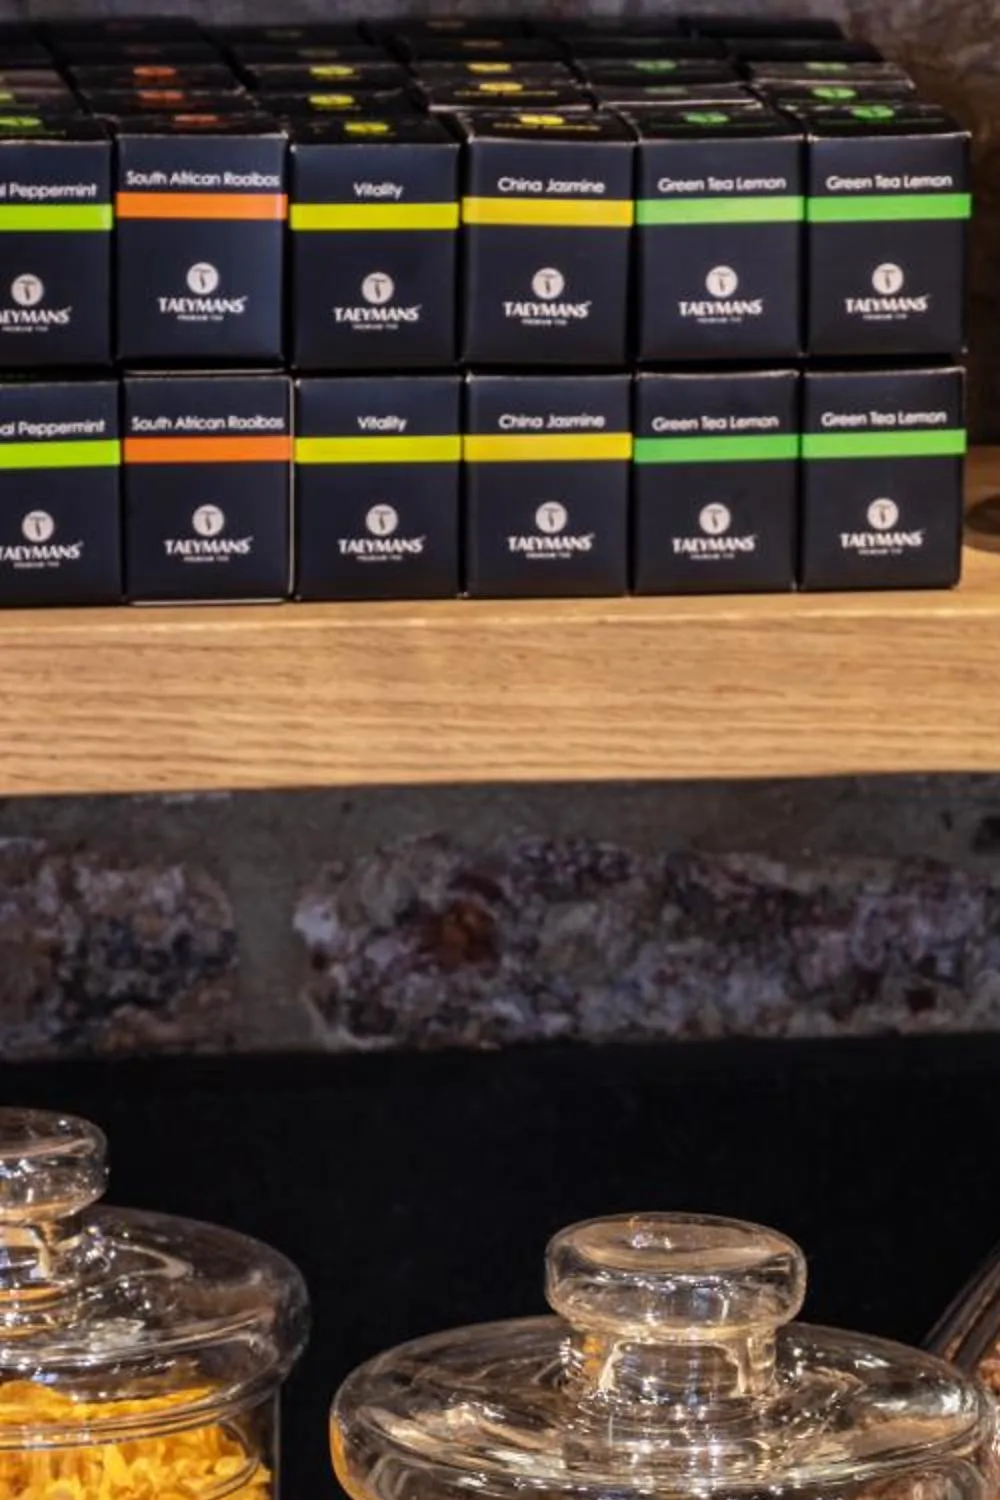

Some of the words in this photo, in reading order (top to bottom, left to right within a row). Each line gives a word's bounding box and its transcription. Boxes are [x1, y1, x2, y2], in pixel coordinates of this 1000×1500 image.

[126, 171, 168, 186] South
[170, 171, 222, 187] African
[224, 171, 281, 187] Rooibos
[498, 176, 543, 193] China
[546, 178, 606, 194] Jasmine
[657, 177, 705, 193] Green
[707, 177, 735, 192] Tea
[736, 176, 787, 191] Lemon
[825, 175, 873, 191] Green
[874, 175, 902, 190] Tea
[903, 174, 953, 189] Lemon
[10, 183, 97, 200] Peppermint
[354, 182, 403, 200] Vitality
[158, 297, 244, 314] TAEYMANS
[503, 302, 588, 319] TAEYMANS
[678, 299, 760, 317] TAEYMANS
[845, 297, 927, 314] TAEYMANS
[333, 307, 418, 323] TAEYMANS
[131, 416, 173, 431] South
[174, 416, 227, 431] African
[228, 415, 285, 430] Rooibos
[357, 415, 408, 432] Vitality
[498, 413, 544, 430] China
[546, 413, 606, 429] Jasmine
[651, 416, 699, 432] Green
[700, 416, 728, 431] Tea
[729, 415, 780, 430] Lemon
[820, 411, 868, 427] Green
[869, 411, 897, 426] Tea
[898, 411, 948, 425] Lemon
[18, 420, 106, 438] Peppermint
[164, 539, 250, 555] TAEYMANS
[338, 538, 422, 554] TAEYMANS
[508, 535, 591, 552] TAEYMANS
[672, 535, 754, 554] TAEYMANS
[840, 531, 921, 549] TAEYMANS
